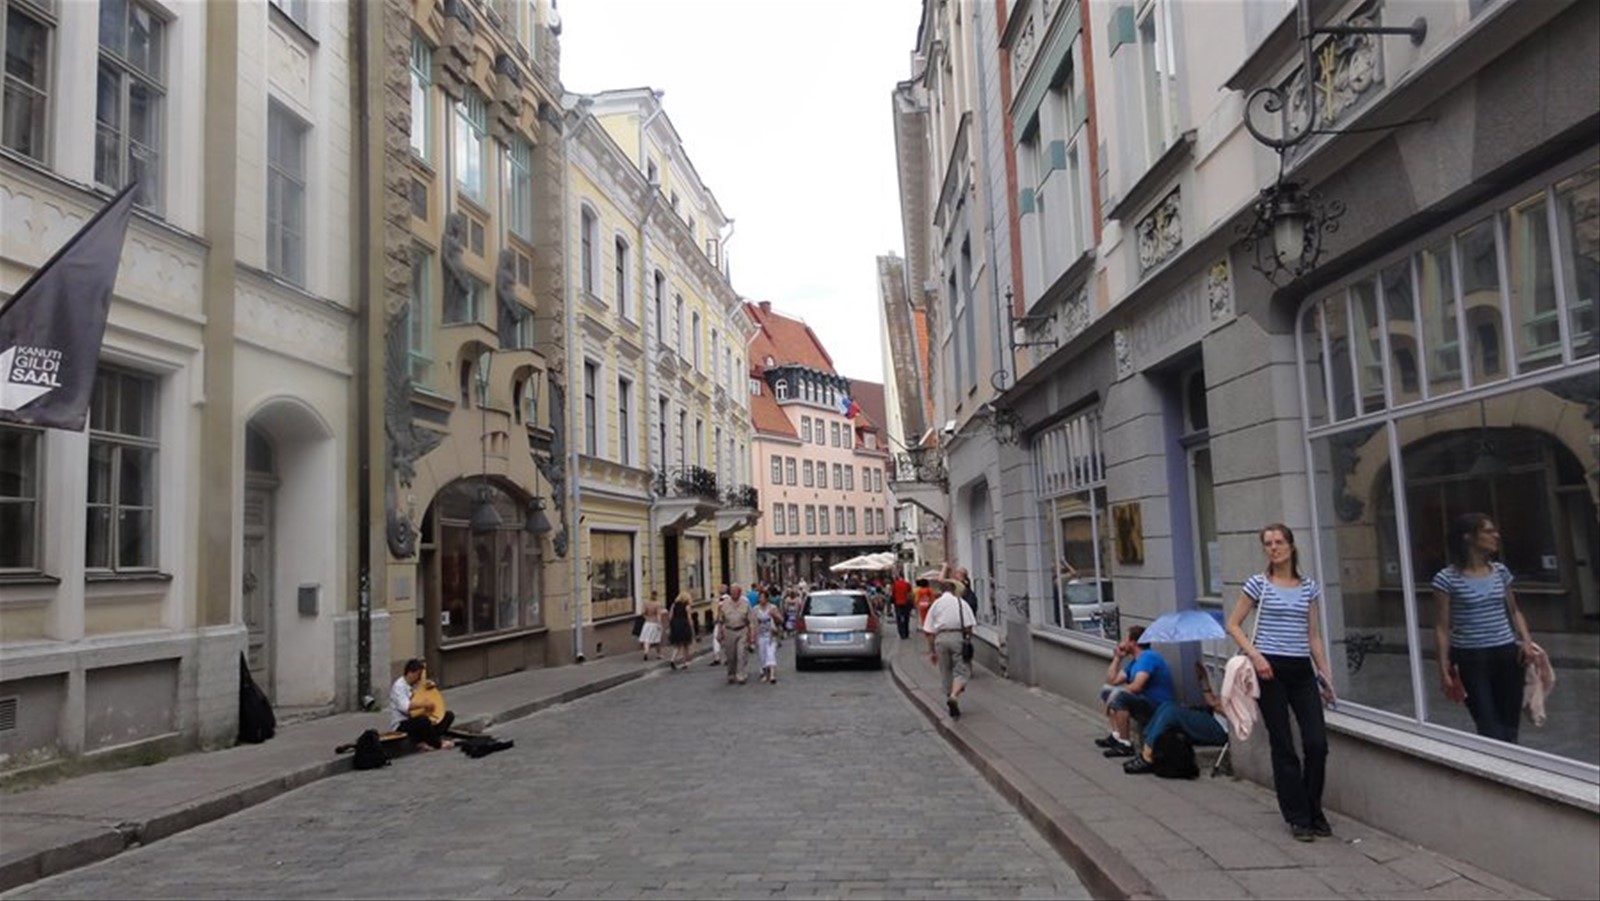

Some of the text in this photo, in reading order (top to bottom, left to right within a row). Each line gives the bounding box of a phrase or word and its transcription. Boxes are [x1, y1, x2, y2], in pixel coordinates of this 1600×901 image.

[18, 346, 62, 359] KANUTI
[15, 355, 60, 372] GILDI
[11, 368, 62, 387] SAAL
